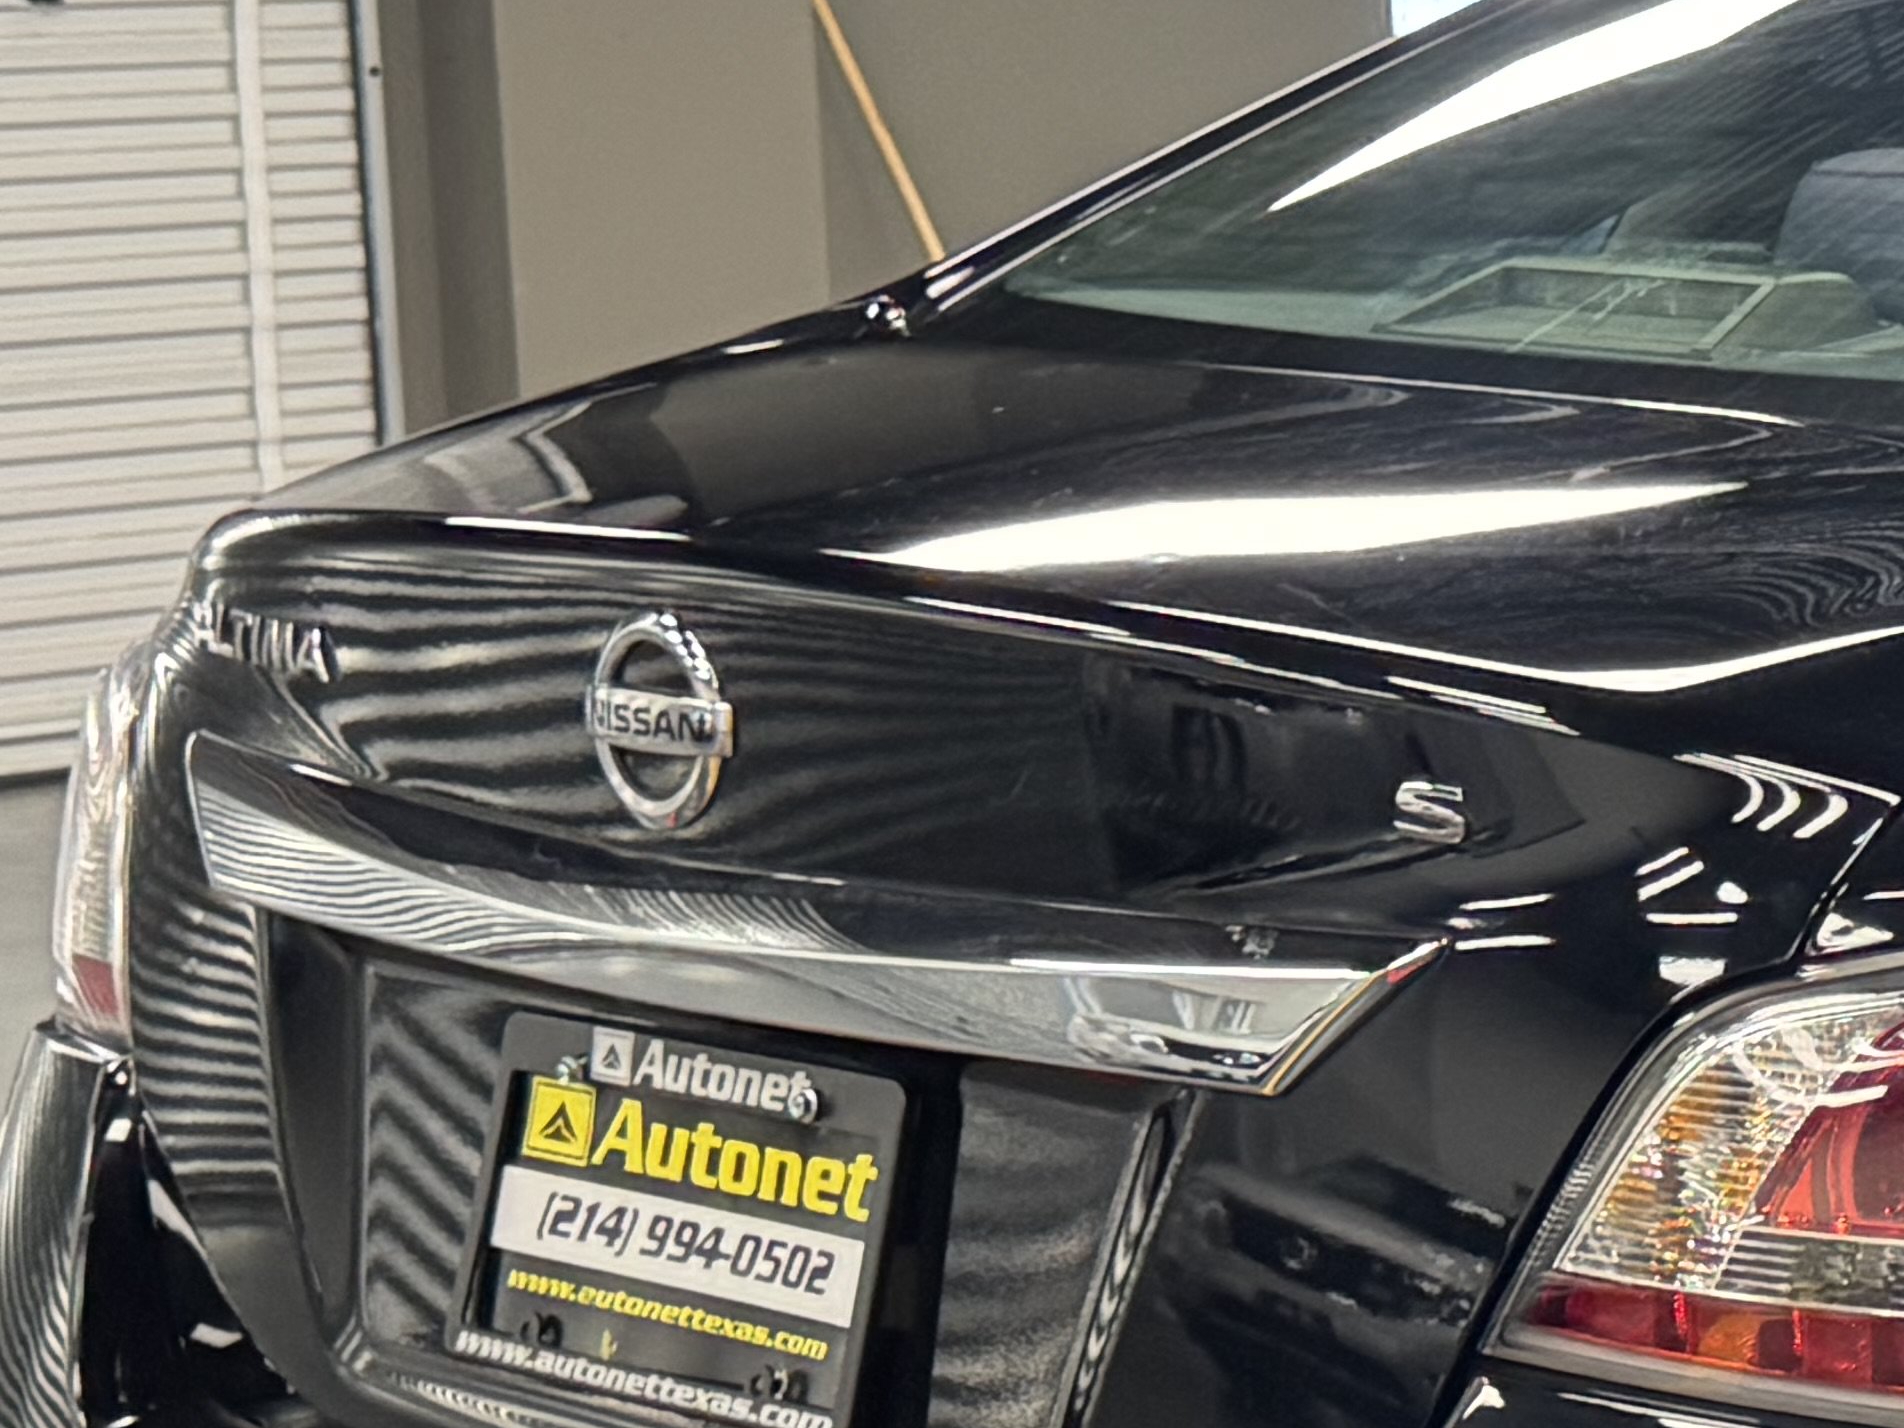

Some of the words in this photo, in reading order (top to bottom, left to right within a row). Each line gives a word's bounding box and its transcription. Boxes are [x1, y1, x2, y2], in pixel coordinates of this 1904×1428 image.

[192, 599, 331, 684] ALTIMA
[596, 698, 719, 744] NISSAN
[1393, 780, 1466, 845] S
[631, 1038, 811, 1113] Autonet
[591, 1097, 878, 1223] Autonet
[536, 1190, 639, 1258] (214)
[640, 1214, 835, 1296] 994-0502
[506, 1268, 829, 1362] www.autonettexas.com
